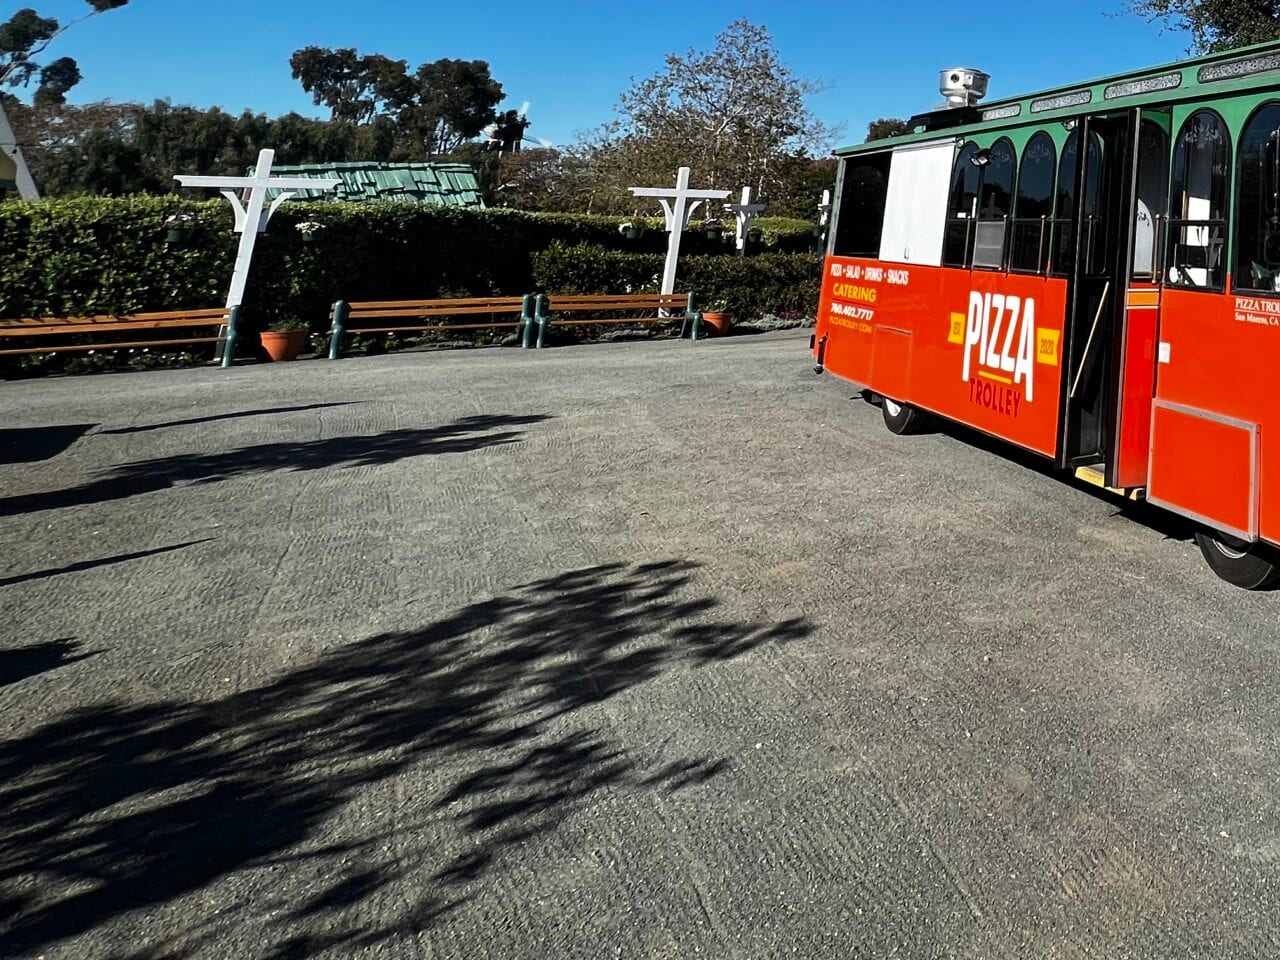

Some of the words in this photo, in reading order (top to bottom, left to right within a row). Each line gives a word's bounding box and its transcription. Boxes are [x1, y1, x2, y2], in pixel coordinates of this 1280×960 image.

[833, 282, 877, 303] CATERING
[1235, 297, 1260, 311] PIZZA
[1269, 316, 1279, 326] CA
[962, 290, 1035, 403] PIZZA
[969, 377, 1021, 418] TROLLEY
